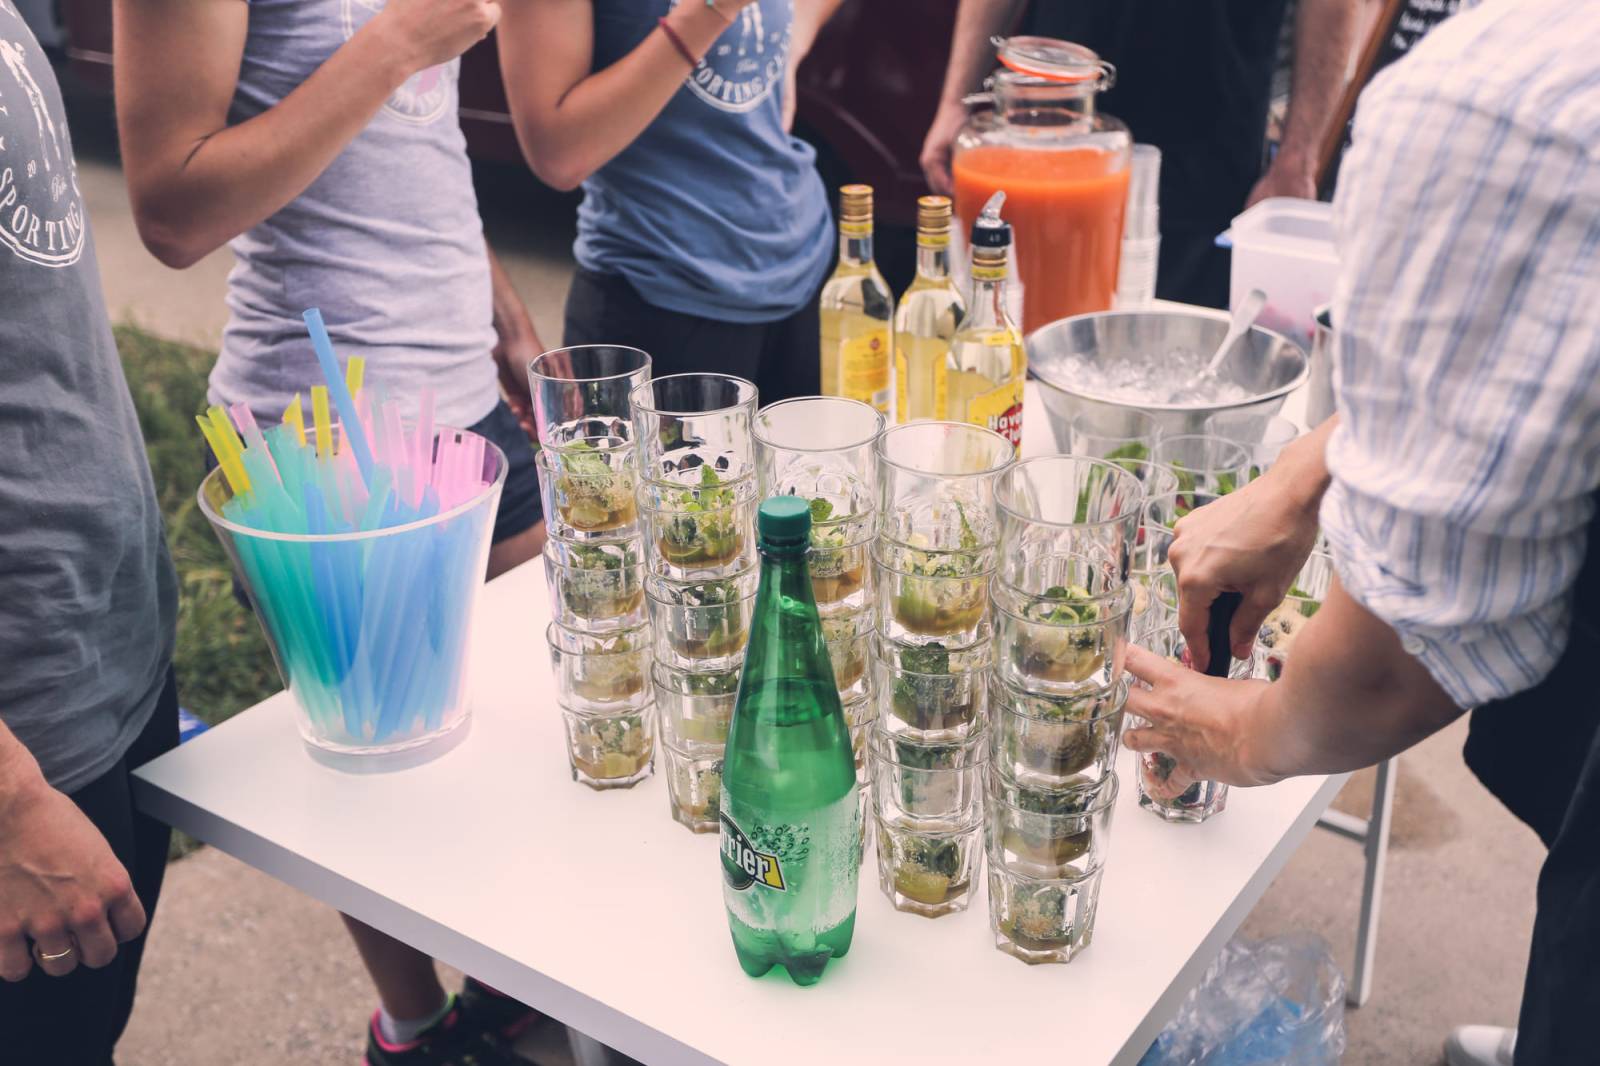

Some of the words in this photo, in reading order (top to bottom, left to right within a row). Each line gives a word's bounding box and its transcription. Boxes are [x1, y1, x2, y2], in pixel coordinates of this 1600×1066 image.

[696, 57, 764, 104] PORTING
[0, 167, 81, 251] SPORTING
[720, 832, 769, 883] rrier
